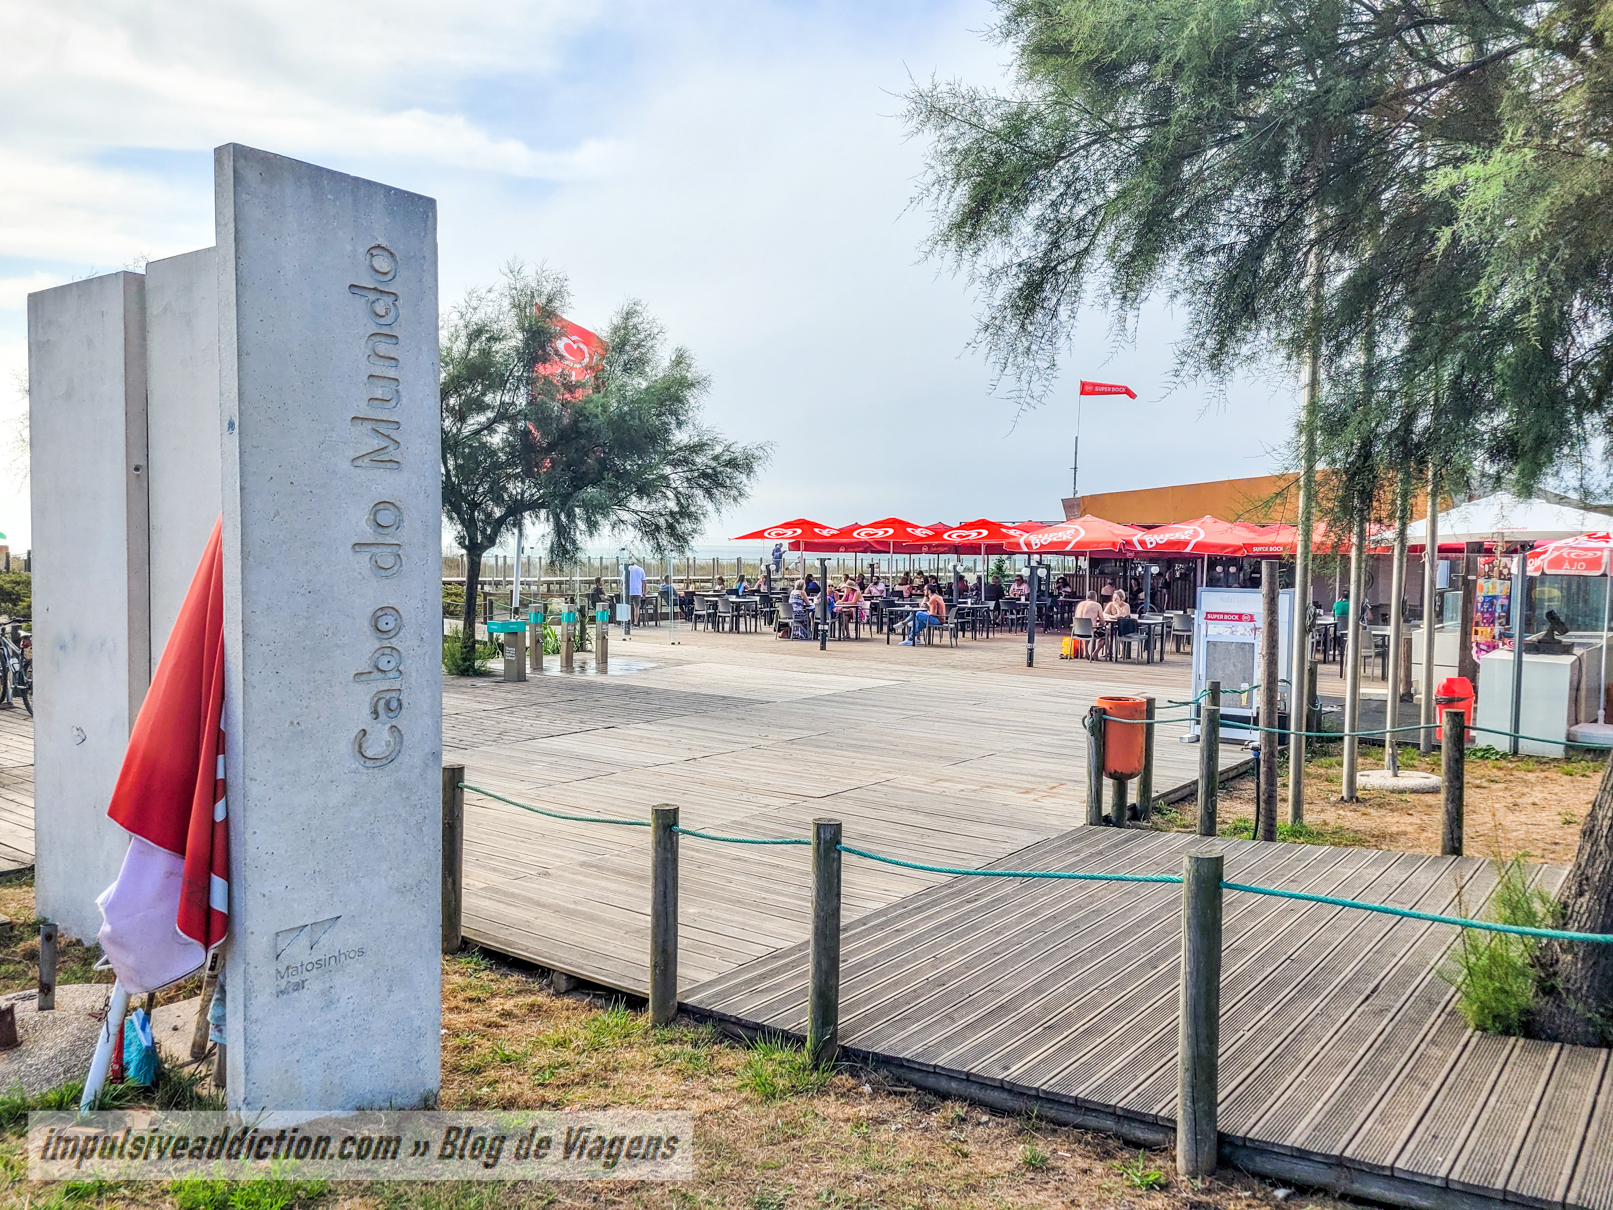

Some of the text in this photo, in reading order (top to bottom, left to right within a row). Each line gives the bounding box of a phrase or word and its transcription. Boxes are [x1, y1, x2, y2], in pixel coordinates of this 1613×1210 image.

[348, 243, 404, 769] Cabo do Mundo
[1028, 528, 1076, 541] SUPER
[1030, 533, 1074, 550] BOCK
[274, 946, 366, 982] Matosinhos
